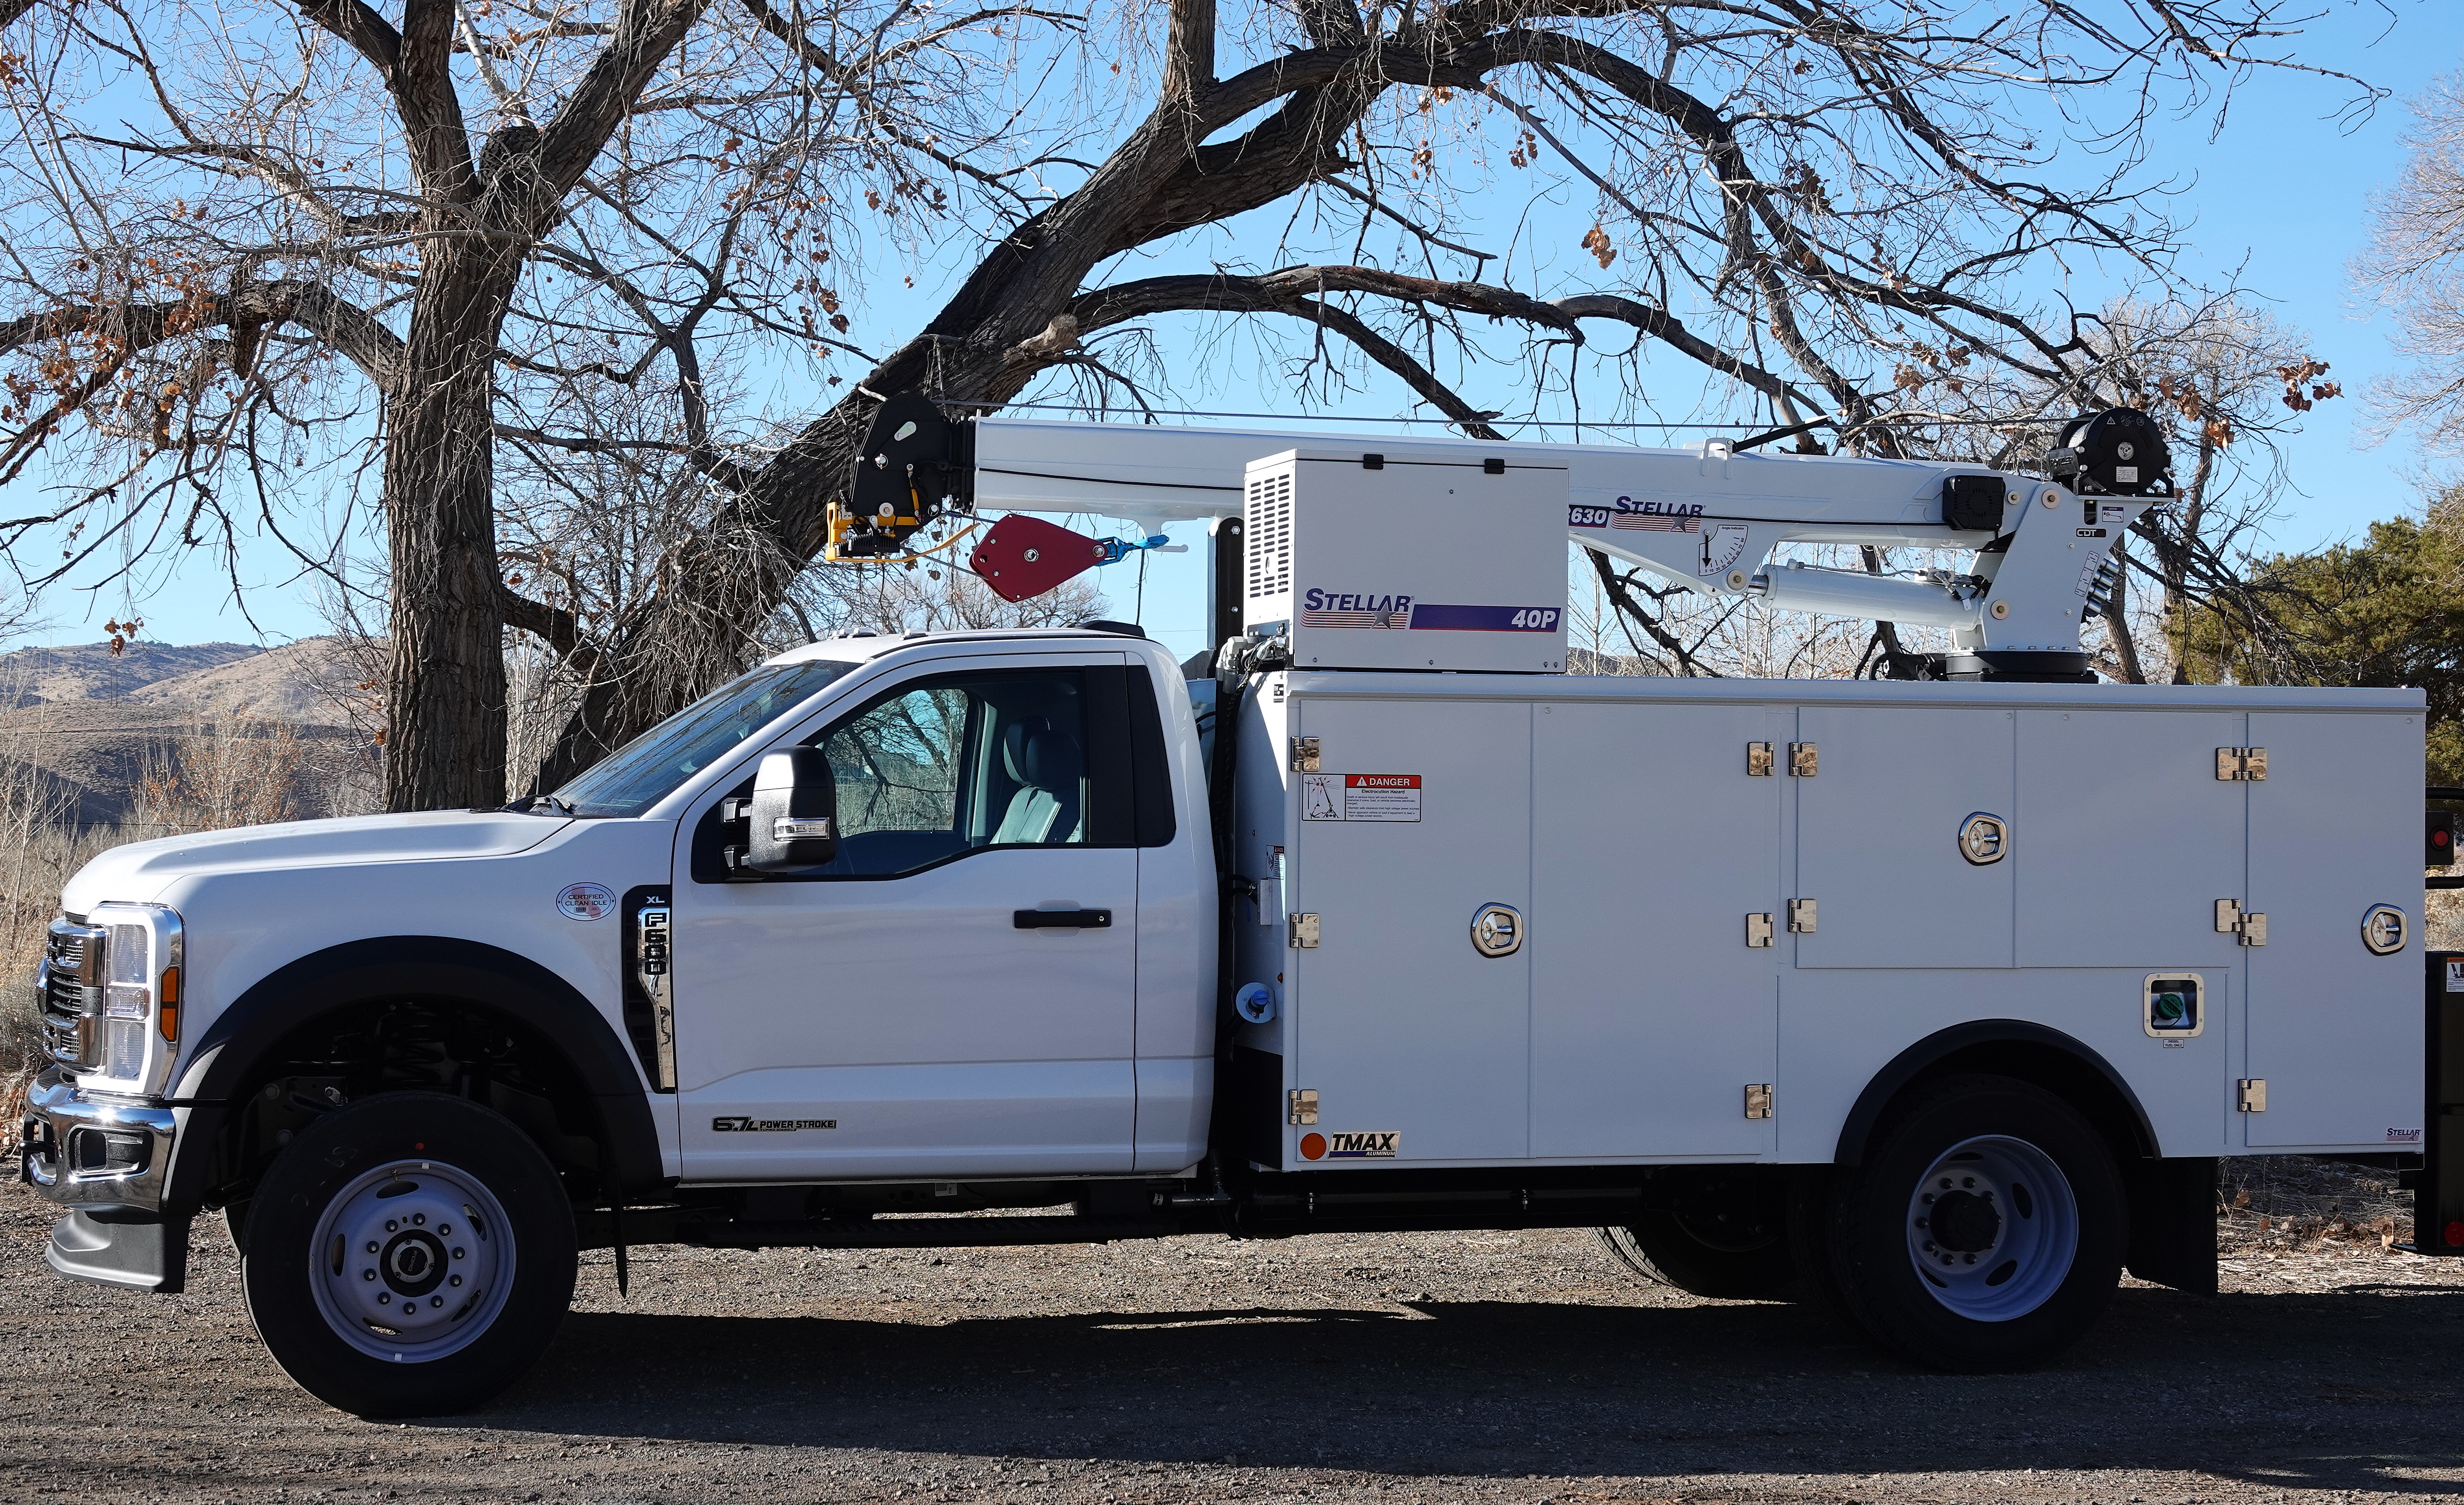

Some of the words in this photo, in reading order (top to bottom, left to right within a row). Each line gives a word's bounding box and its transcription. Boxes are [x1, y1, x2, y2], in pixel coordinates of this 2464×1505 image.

[1303, 588, 1411, 612] STELLAR
[1511, 609, 1557, 629] 40P
[1369, 778, 1410, 786] DANGER
[2387, 1128, 2420, 1136] STELLAR
[1332, 1133, 1396, 1151] TMAX
[408, 1250, 417, 1271] FORD
